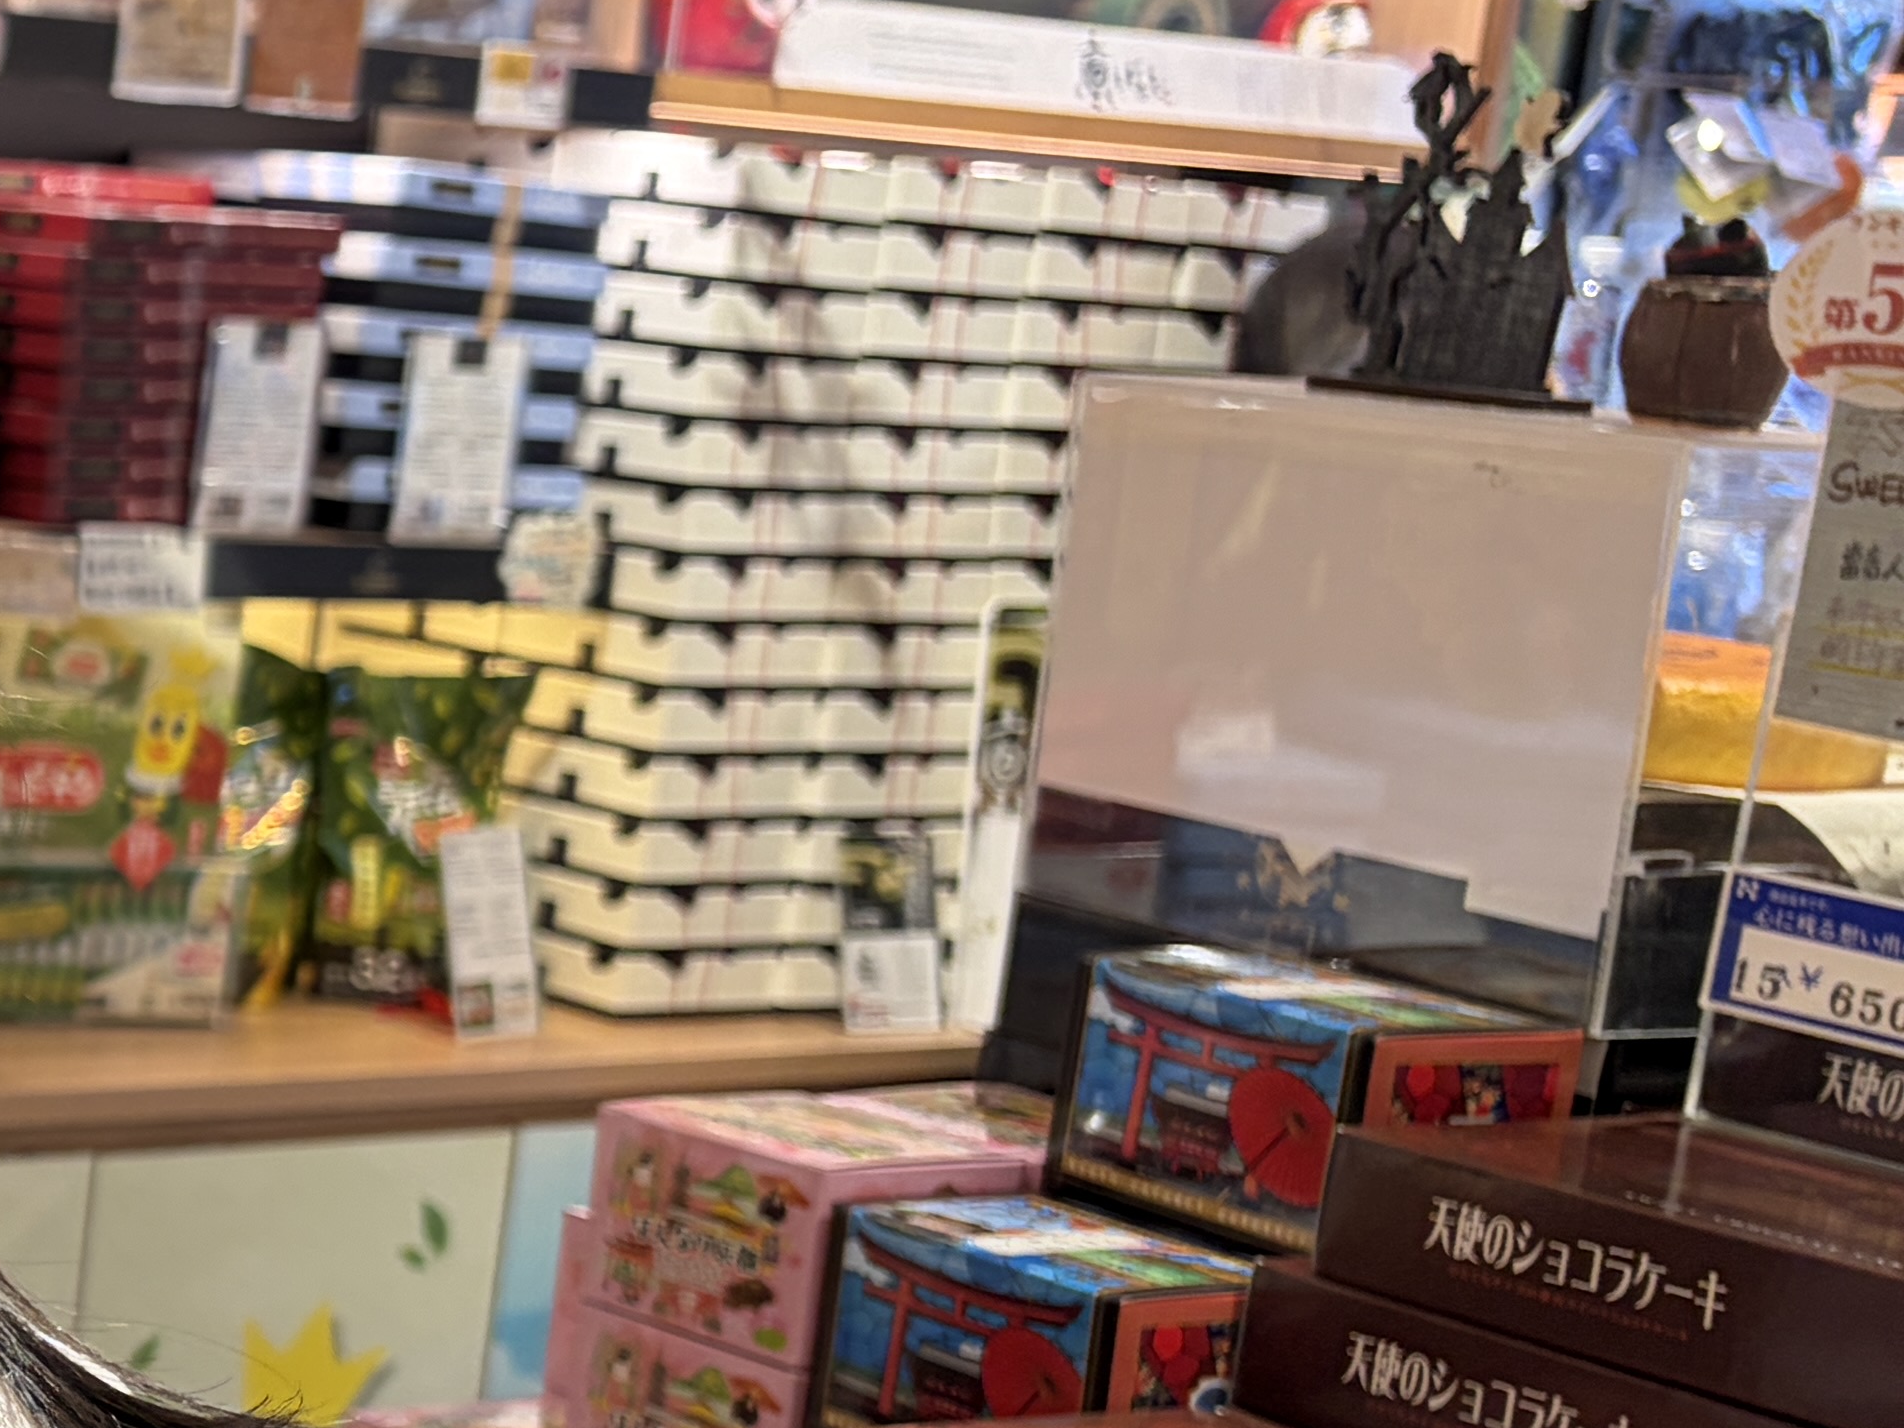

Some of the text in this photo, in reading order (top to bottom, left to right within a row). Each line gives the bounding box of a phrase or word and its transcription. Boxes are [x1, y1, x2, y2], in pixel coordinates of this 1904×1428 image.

[1423, 1196, 1729, 1332] 天使のショコラケーキ
